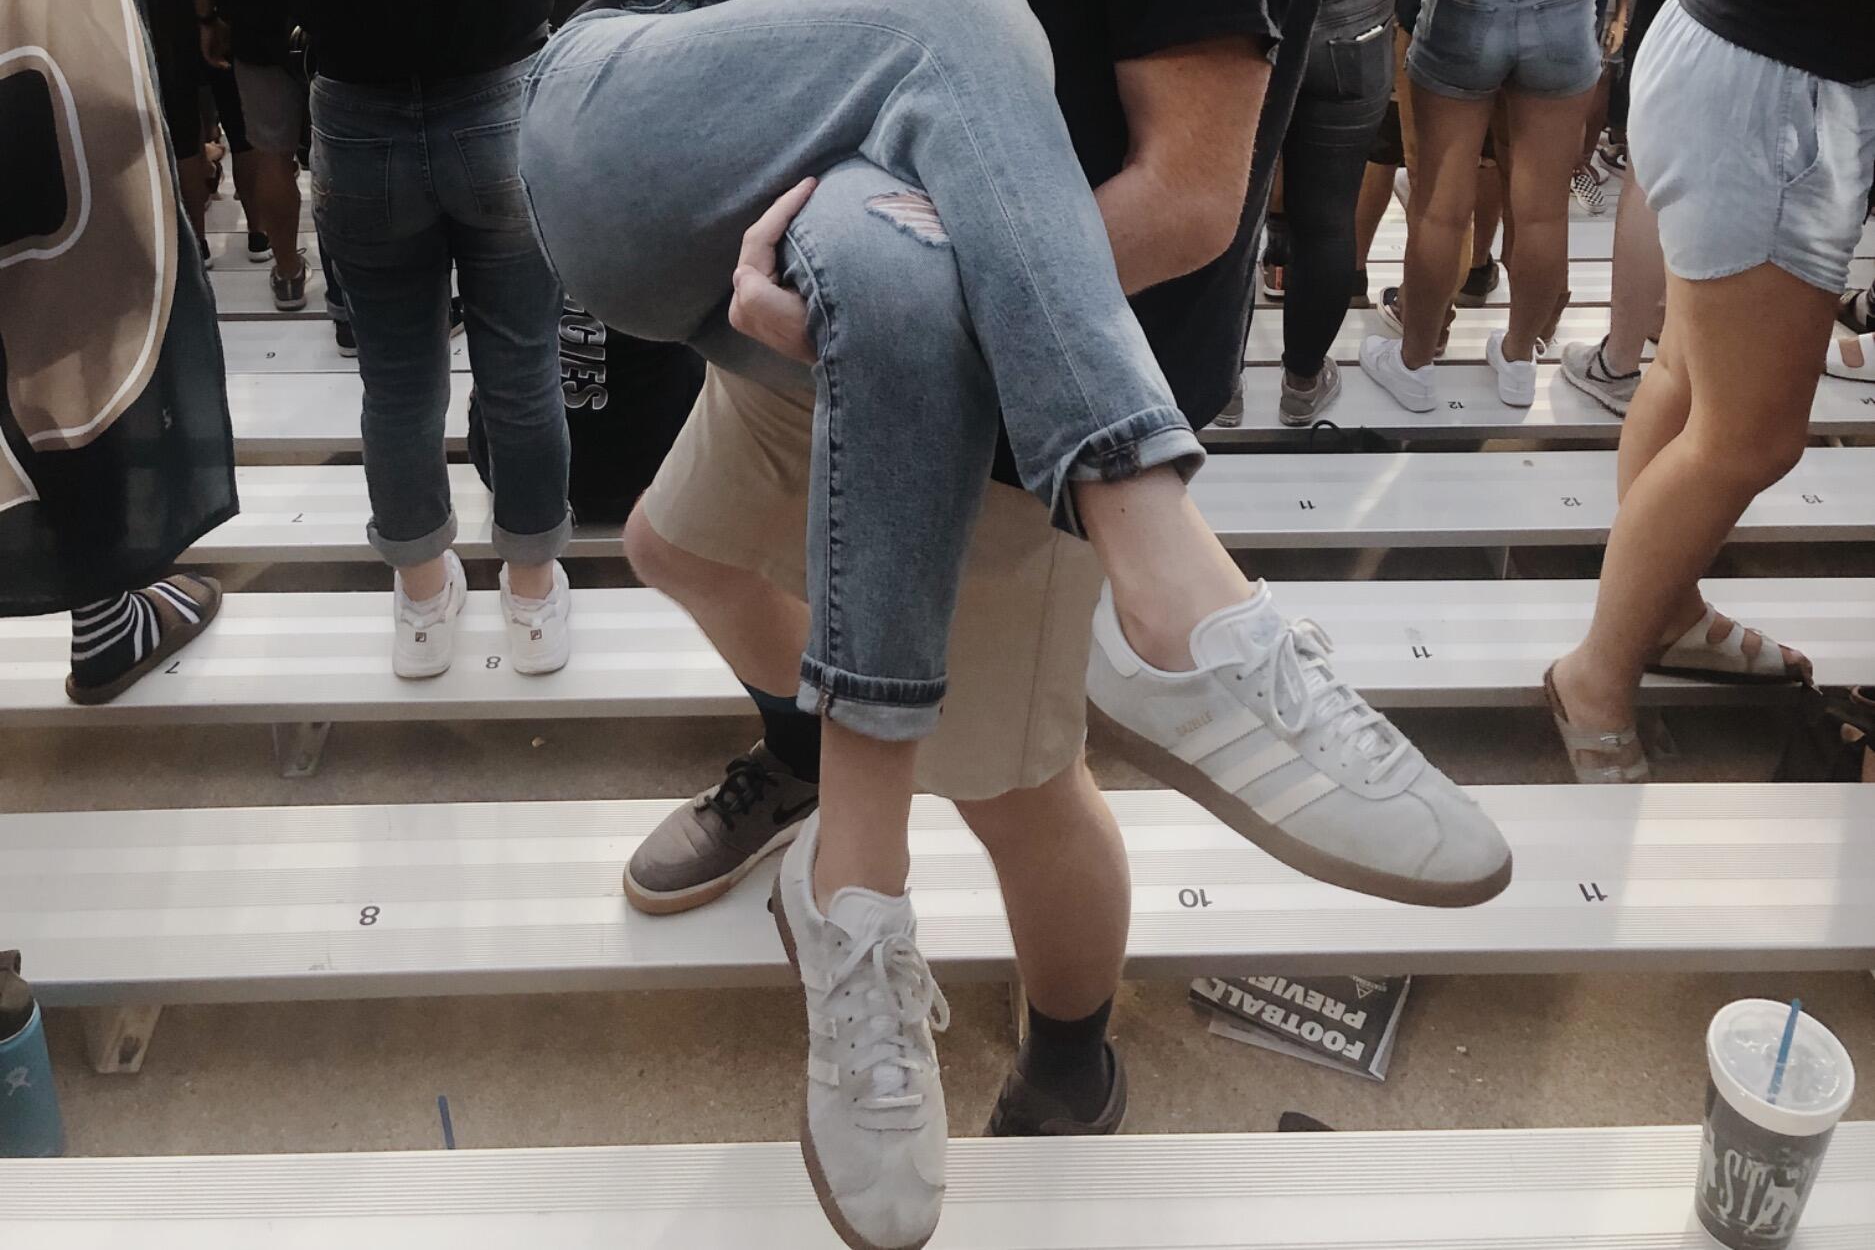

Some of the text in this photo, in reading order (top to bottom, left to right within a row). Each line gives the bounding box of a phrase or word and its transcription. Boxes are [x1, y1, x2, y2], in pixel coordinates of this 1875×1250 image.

[1560, 496, 1583, 508] 12
[485, 655, 502, 670] 8
[1411, 645, 1433, 659] 11
[1178, 888, 1213, 909] 10
[1578, 882, 1609, 903] 11
[358, 905, 381, 927] 8
[1241, 975, 1368, 1030] PREVIE
[1191, 977, 1366, 1061] FOOTBALL
